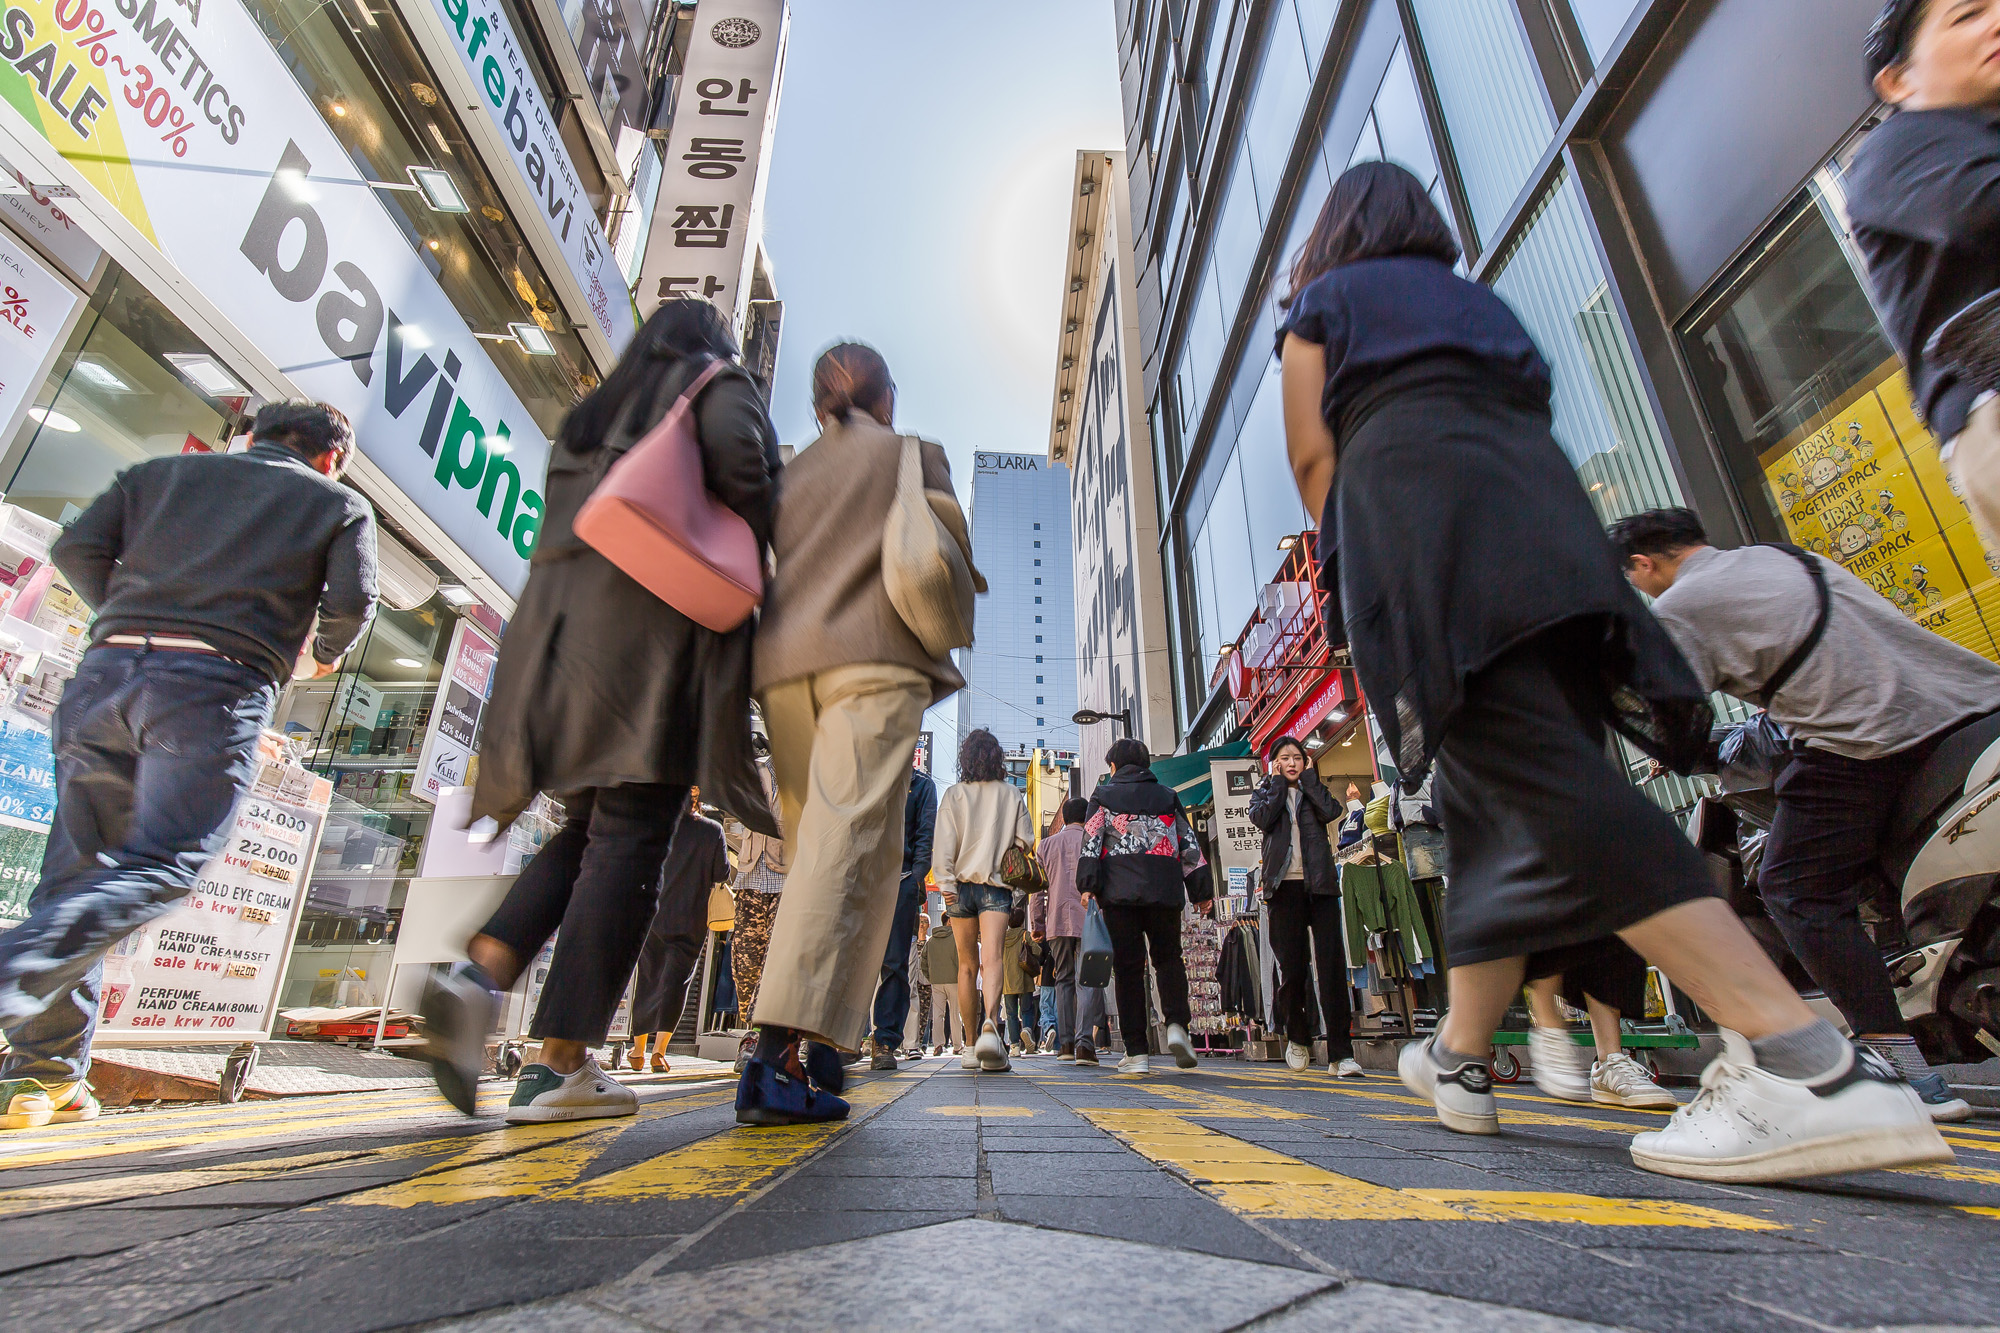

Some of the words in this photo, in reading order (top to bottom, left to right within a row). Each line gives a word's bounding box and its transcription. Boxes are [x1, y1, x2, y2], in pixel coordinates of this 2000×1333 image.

[0, 8, 107, 140] SALE
[502, 37, 524, 87] TEA
[534, 109, 579, 197] DESSERT
[239, 137, 546, 561] bavipha
[1792, 424, 1835, 469] HBAF
[977, 454, 1038, 471] SOLARIA
[1789, 481, 1849, 526] TOGETHER
[1847, 458, 1882, 489] PACK
[1818, 489, 1865, 534] HBAF
[1878, 530, 1916, 560] PACK
[461, 653, 484, 678] HOUSE
[464, 643, 486, 667] ETUDE
[455, 667, 468, 682] 40%
[468, 676, 483, 693] SALE
[445, 701, 475, 726] Sulwhasoo
[440, 720, 454, 736] 50%
[454, 729, 470, 745] SALE
[236, 815, 261, 832] krw
[224, 852, 251, 869] krw
[239, 839, 298, 866] 22,000
[196, 879, 229, 897] GOLD
[232, 886, 254, 903] EYE
[256, 891, 292, 910] CREAM
[211, 900, 238, 915] krw
[157, 940, 195, 954] HAND
[160, 929, 218, 946] PERFUME
[153, 956, 186, 969] sale
[193, 958, 221, 972] krw
[234, 965, 257, 977] 4200
[137, 998, 177, 1010] HAND
[140, 987, 202, 1000] PERFUME
[131, 1014, 166, 1027] sale
[174, 1015, 204, 1027] krw
[209, 1016, 235, 1028] 700
